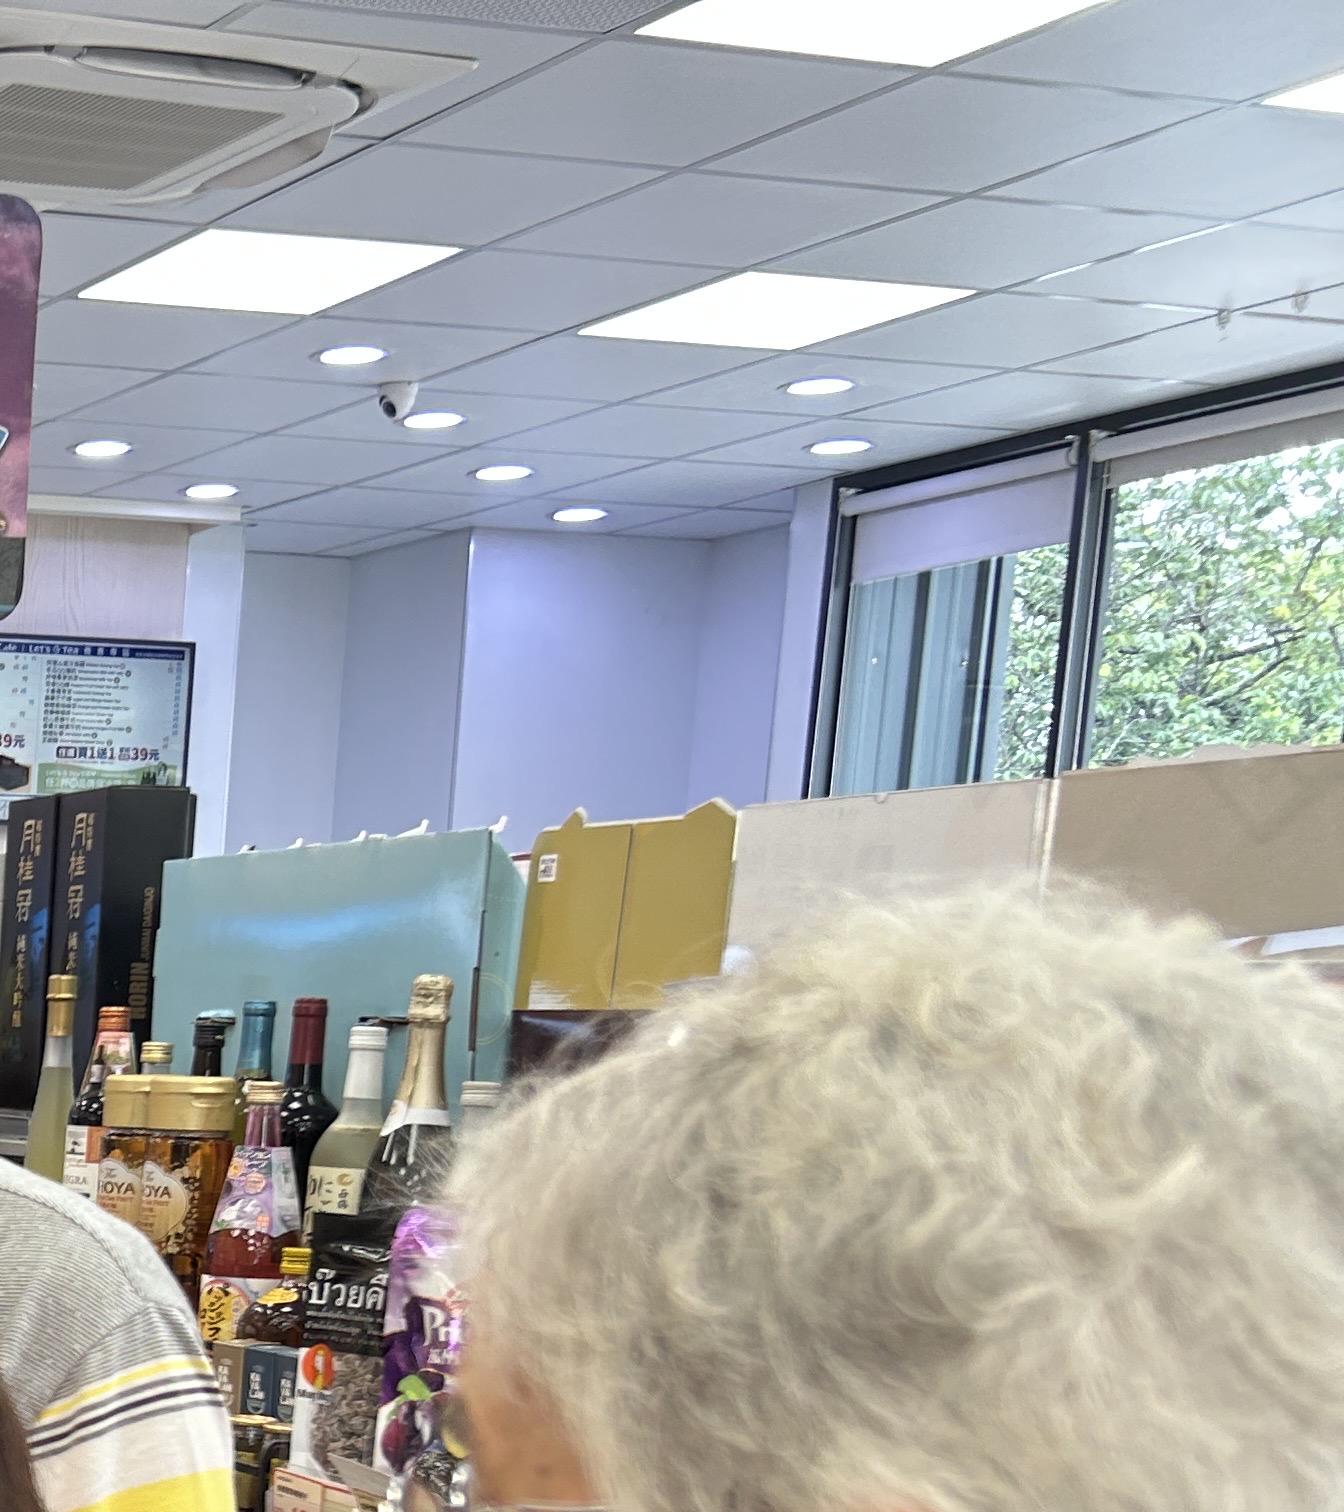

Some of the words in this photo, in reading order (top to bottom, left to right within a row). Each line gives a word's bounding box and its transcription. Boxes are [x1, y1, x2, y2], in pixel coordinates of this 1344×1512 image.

[16, 818, 37, 923] 月桂冠
[66, 812, 89, 920] 月桂冠
